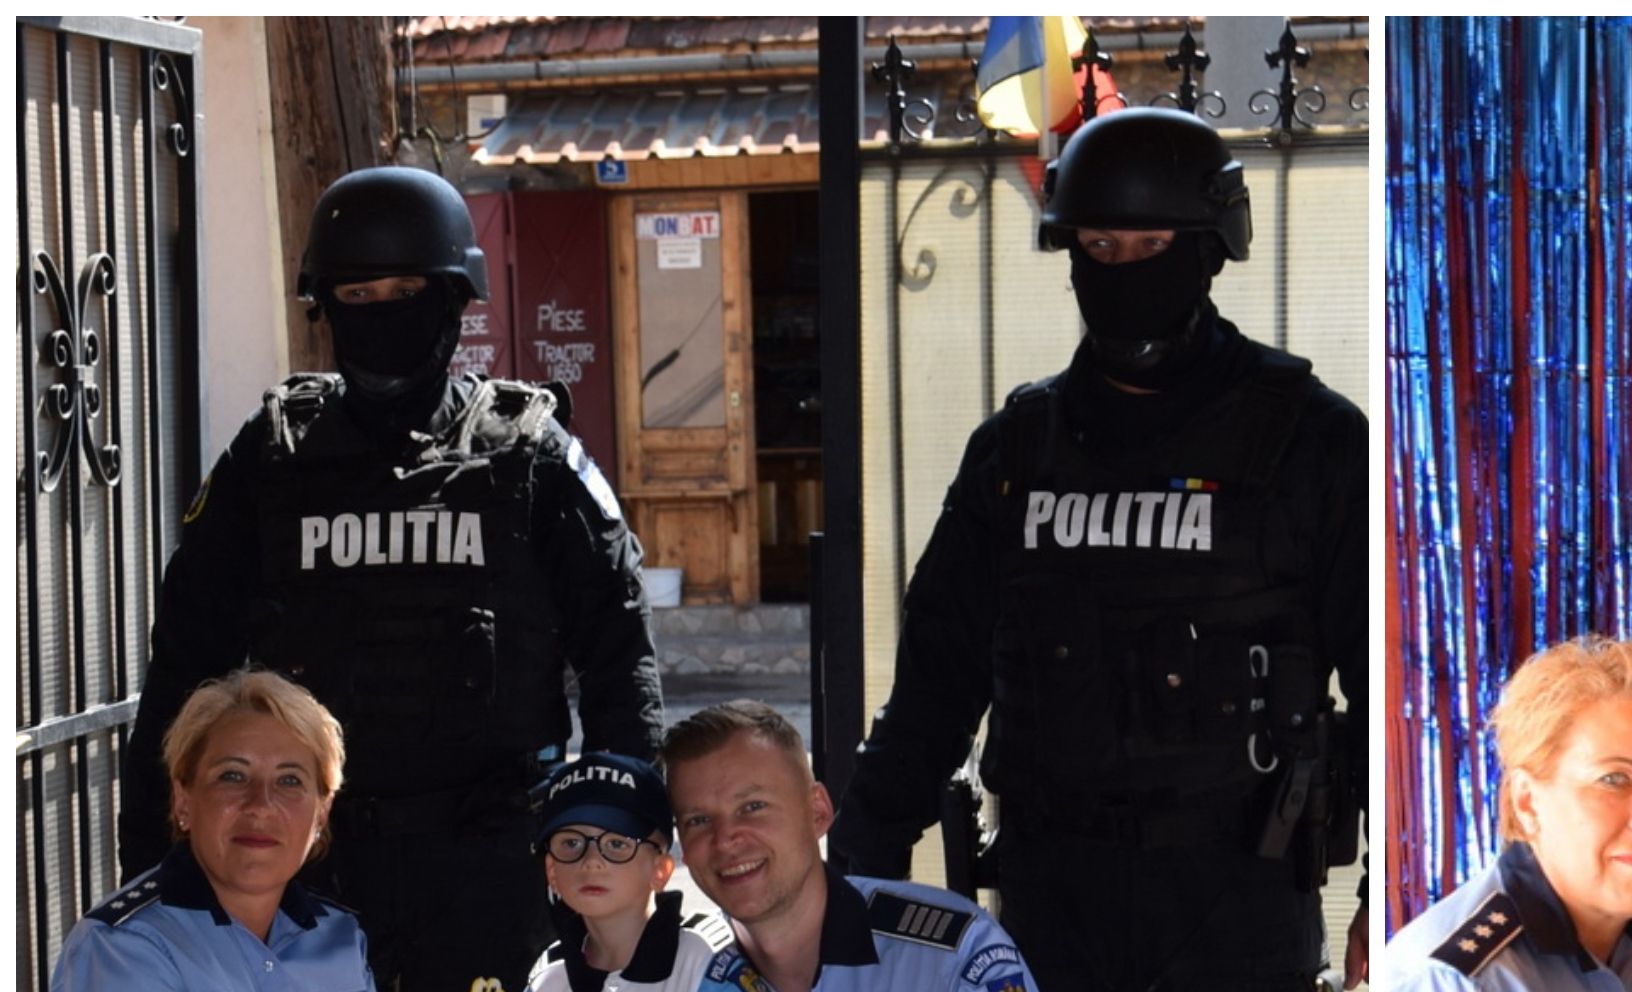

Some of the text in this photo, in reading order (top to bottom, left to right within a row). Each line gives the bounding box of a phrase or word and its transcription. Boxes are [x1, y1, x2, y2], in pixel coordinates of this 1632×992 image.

[301, 511, 485, 569] POLITIA
[1025, 491, 1212, 550] POLITIA
[549, 766, 636, 800] POLITIA
